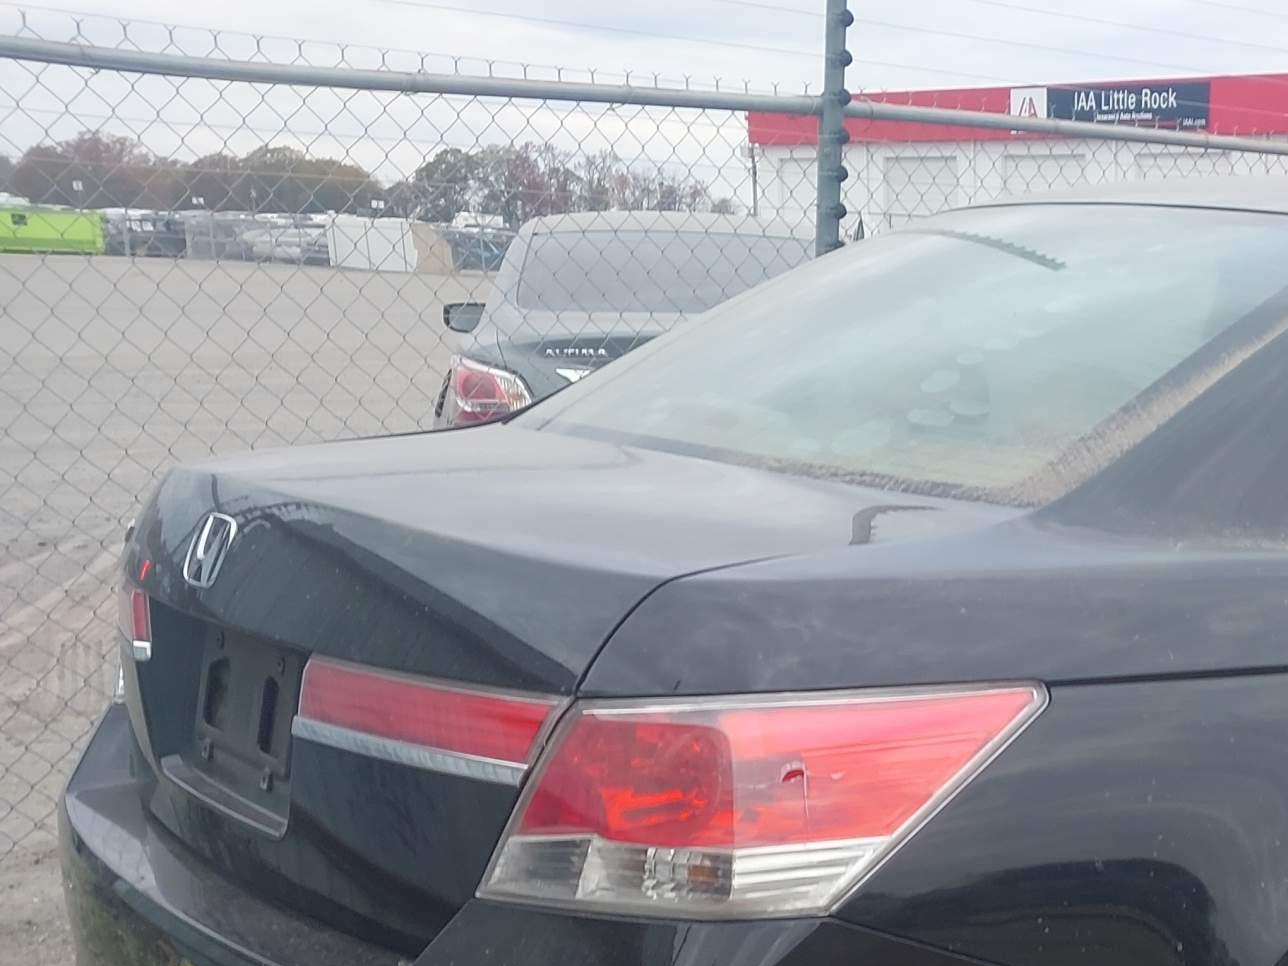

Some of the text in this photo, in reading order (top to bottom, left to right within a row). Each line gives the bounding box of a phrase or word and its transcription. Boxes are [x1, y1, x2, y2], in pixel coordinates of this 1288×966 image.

[1073, 87, 1177, 112] IAA Little Rock
